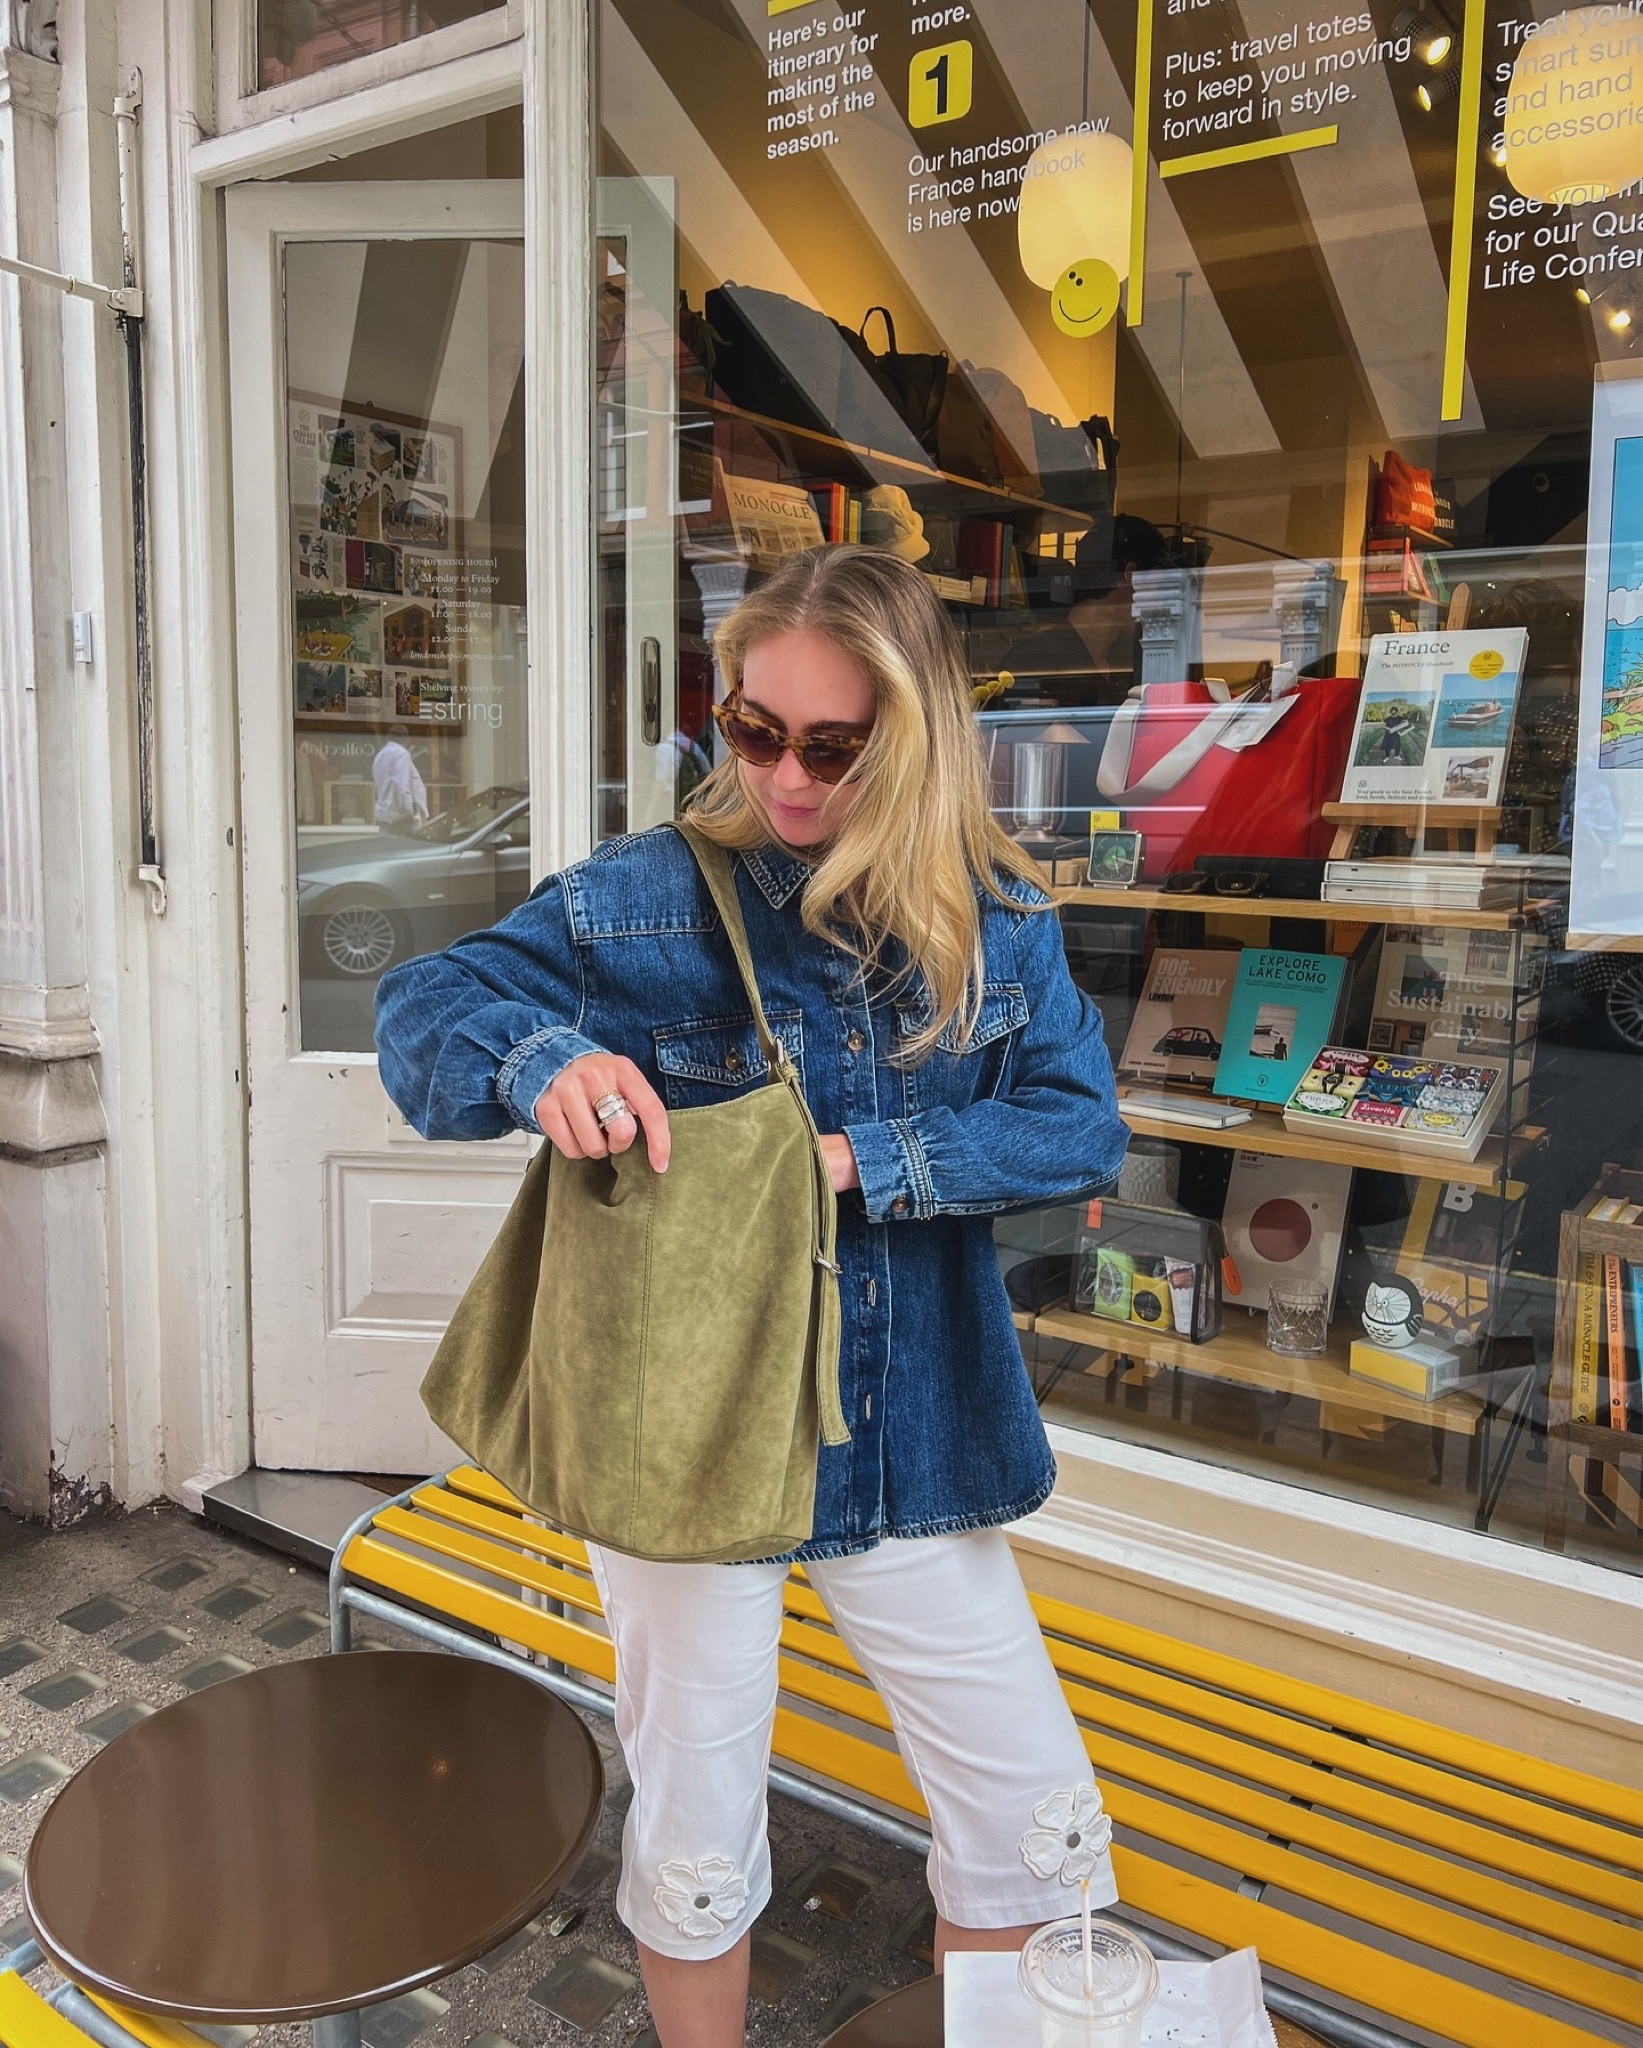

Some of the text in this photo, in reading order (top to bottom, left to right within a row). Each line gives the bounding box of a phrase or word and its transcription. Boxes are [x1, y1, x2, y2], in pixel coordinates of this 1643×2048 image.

[911, 5, 971, 35] more.
[1167, 0, 1210, 15] an
[768, 8, 867, 52] Here’s our
[1497, 9, 1570, 47] Treat
[767, 33, 879, 79] itinerary for
[1165, 12, 1373, 78] Plus: travel totes
[1163, 35, 1412, 110] to keep you moving
[1495, 43, 1579, 82] smart
[767, 63, 875, 107] making the
[925, 54, 950, 116] 1
[1493, 66, 1634, 117] and hand
[767, 90, 875, 133] most of the
[1162, 81, 1357, 141] forward in style.
[767, 129, 840, 160] season.
[908, 116, 1110, 177] Our handsome new
[908, 148, 1086, 205] France handbook
[1487, 194, 1543, 220] See
[1550, 184, 1607, 217] you
[907, 213, 923, 234] is
[929, 207, 972, 229] here
[1485, 229, 1526, 255] for
[1533, 221, 1584, 247] our
[1483, 260, 1536, 290] Life
[733, 491, 812, 520] MONOCLE
[421, 573, 500, 585] Monday to Friday
[442, 599, 480, 609] Saturday
[445, 624, 479, 634] Sunday
[1383, 639, 1450, 656] France
[420, 682, 457, 693] Shelving
[435, 697, 503, 728] string
[1157, 957, 1198, 976] DOG-
[1248, 966, 1327, 984] LAKE COMO
[1259, 955, 1320, 971] EXPLORE
[1153, 976, 1227, 997] FRIENDLY
[1440, 971, 1486, 994] The
[1387, 988, 1530, 1022] Sustainable
[1430, 1018, 1482, 1046] City
